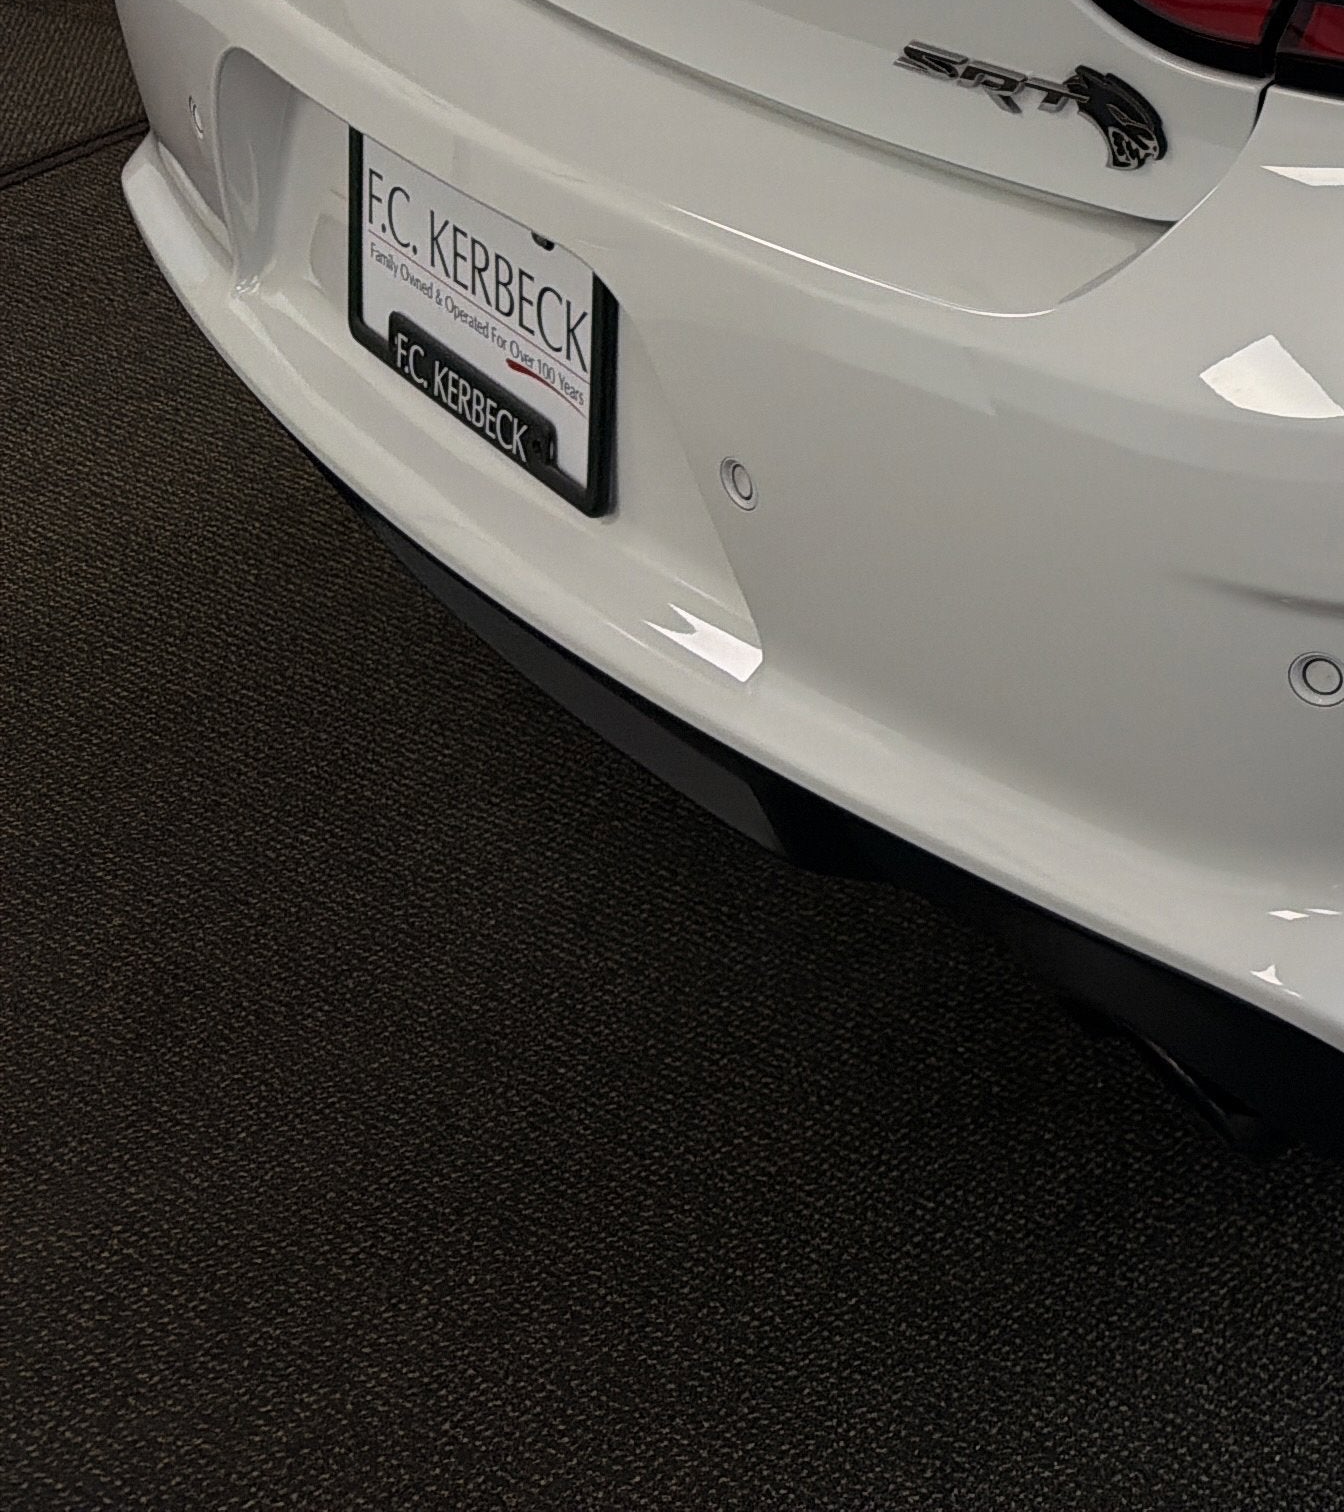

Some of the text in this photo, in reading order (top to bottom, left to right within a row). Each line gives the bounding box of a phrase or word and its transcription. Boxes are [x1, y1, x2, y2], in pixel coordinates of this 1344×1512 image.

[368, 167, 590, 374] F.C. KERBECK
[370, 242, 399, 278] Family
[400, 262, 434, 300] Owned
[444, 295, 490, 339] Operated
[491, 330, 507, 352] For
[510, 340, 535, 371] Over
[538, 359, 556, 385] 100
[558, 371, 585, 407] Years
[394, 332, 529, 464] F.C. KERBECK
